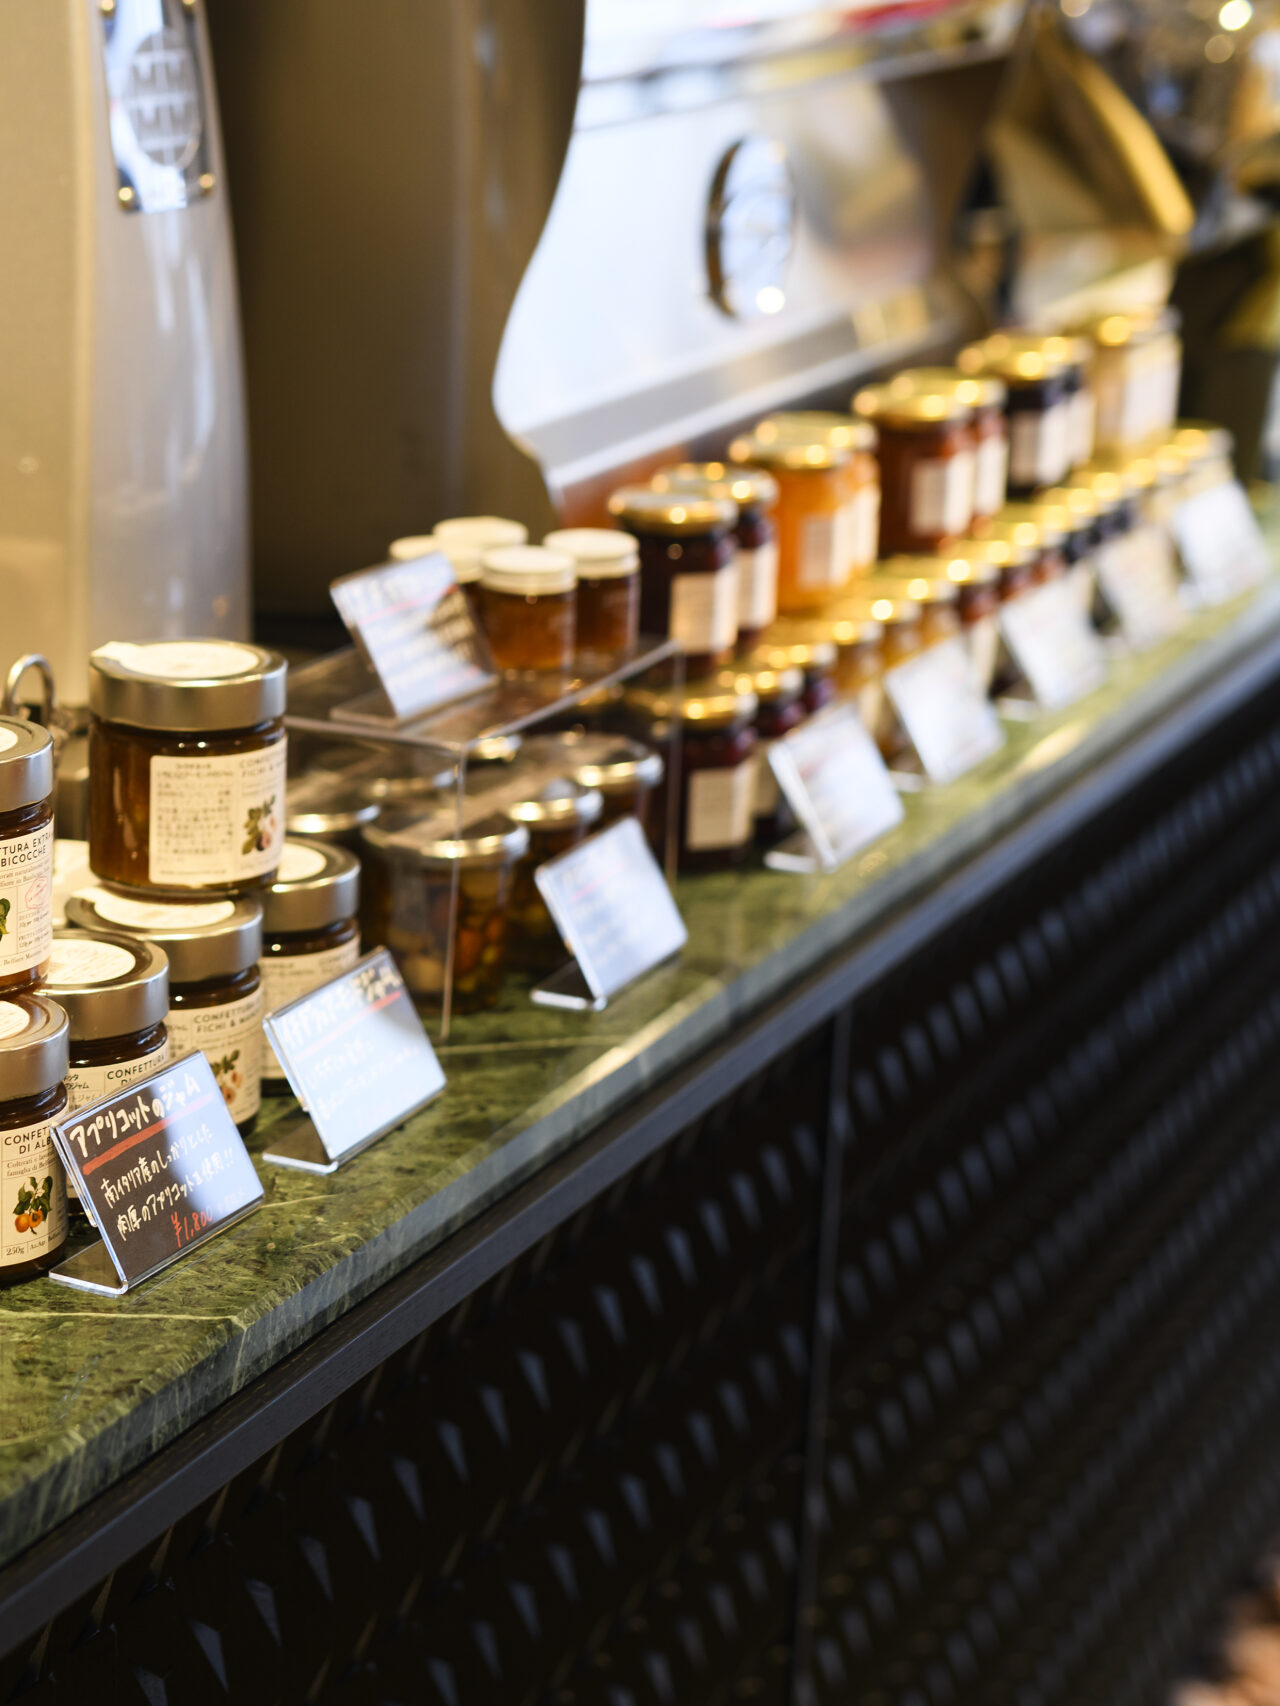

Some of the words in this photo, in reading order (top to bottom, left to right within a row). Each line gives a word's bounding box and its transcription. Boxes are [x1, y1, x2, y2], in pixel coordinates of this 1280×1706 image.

[70, 1072, 201, 1158] アプリコットのジャム
[20, 1144, 30, 1154] DI
[170, 1205, 213, 1248] ¥1,800
